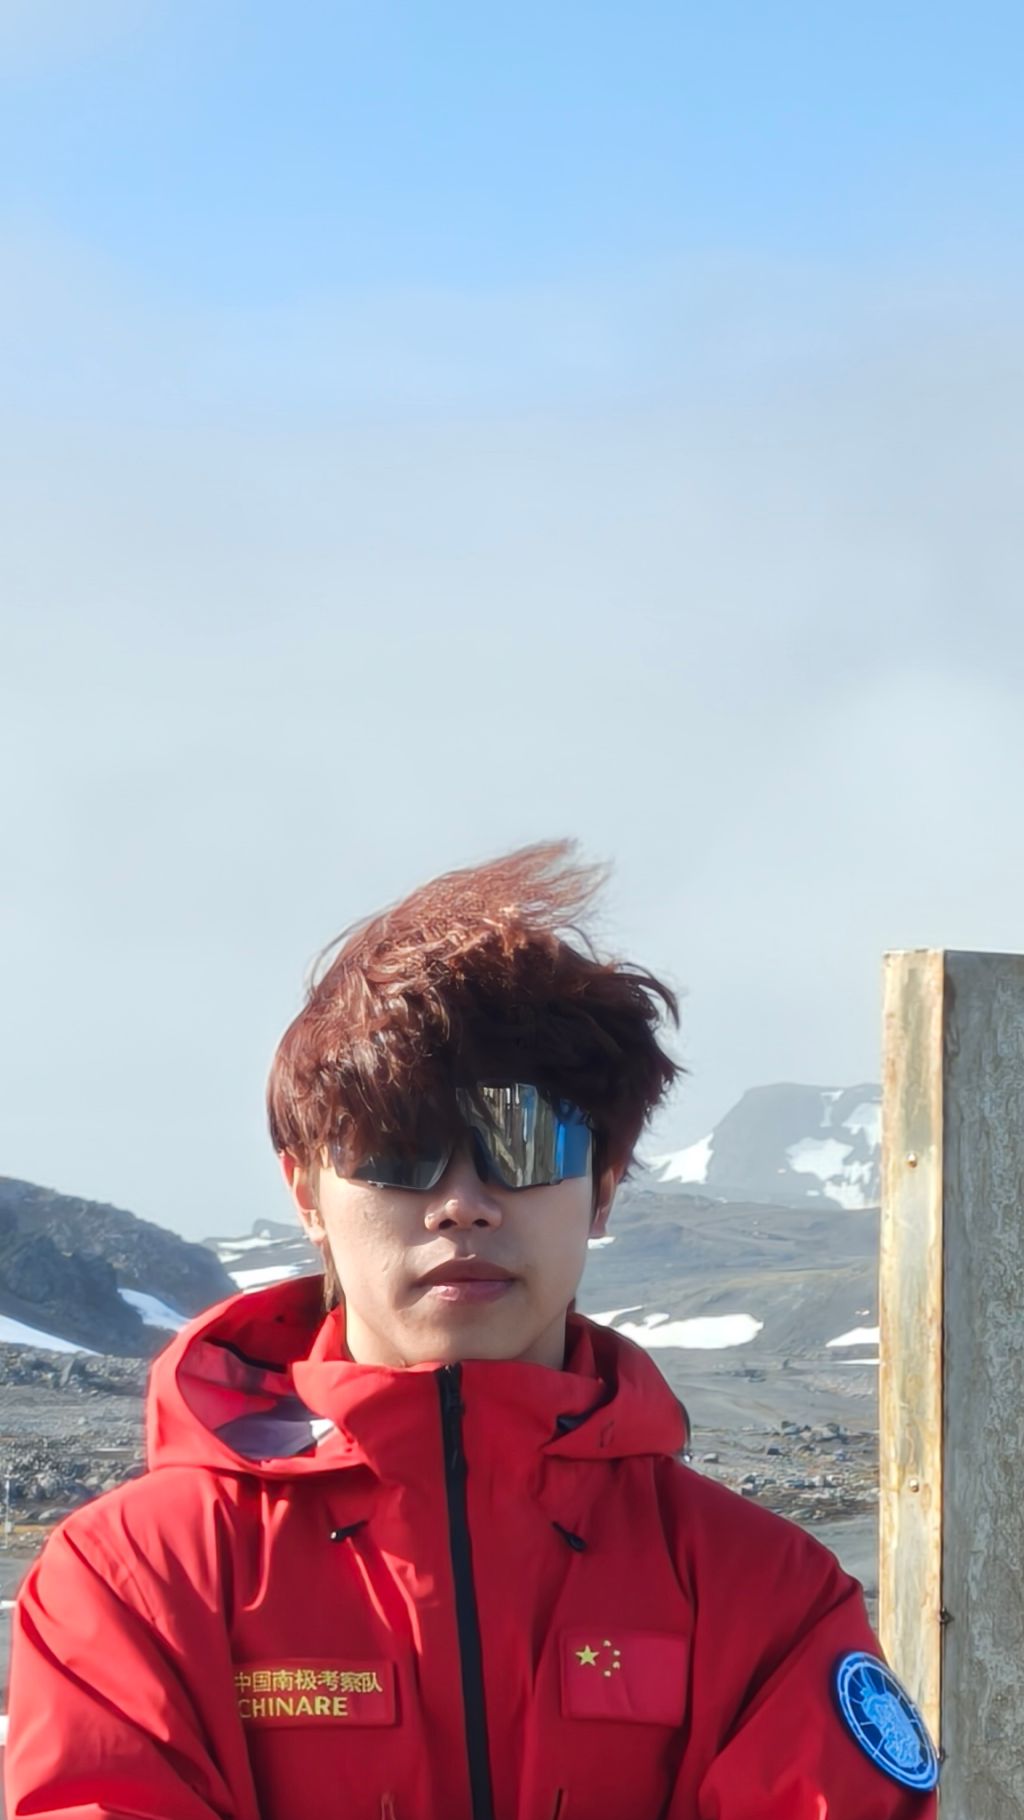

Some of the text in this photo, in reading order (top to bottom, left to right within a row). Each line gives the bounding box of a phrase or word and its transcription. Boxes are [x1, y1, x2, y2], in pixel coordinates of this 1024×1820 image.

[234, 1669, 383, 1693] 中国南极考察队
[238, 1695, 348, 1718] CHINARE
